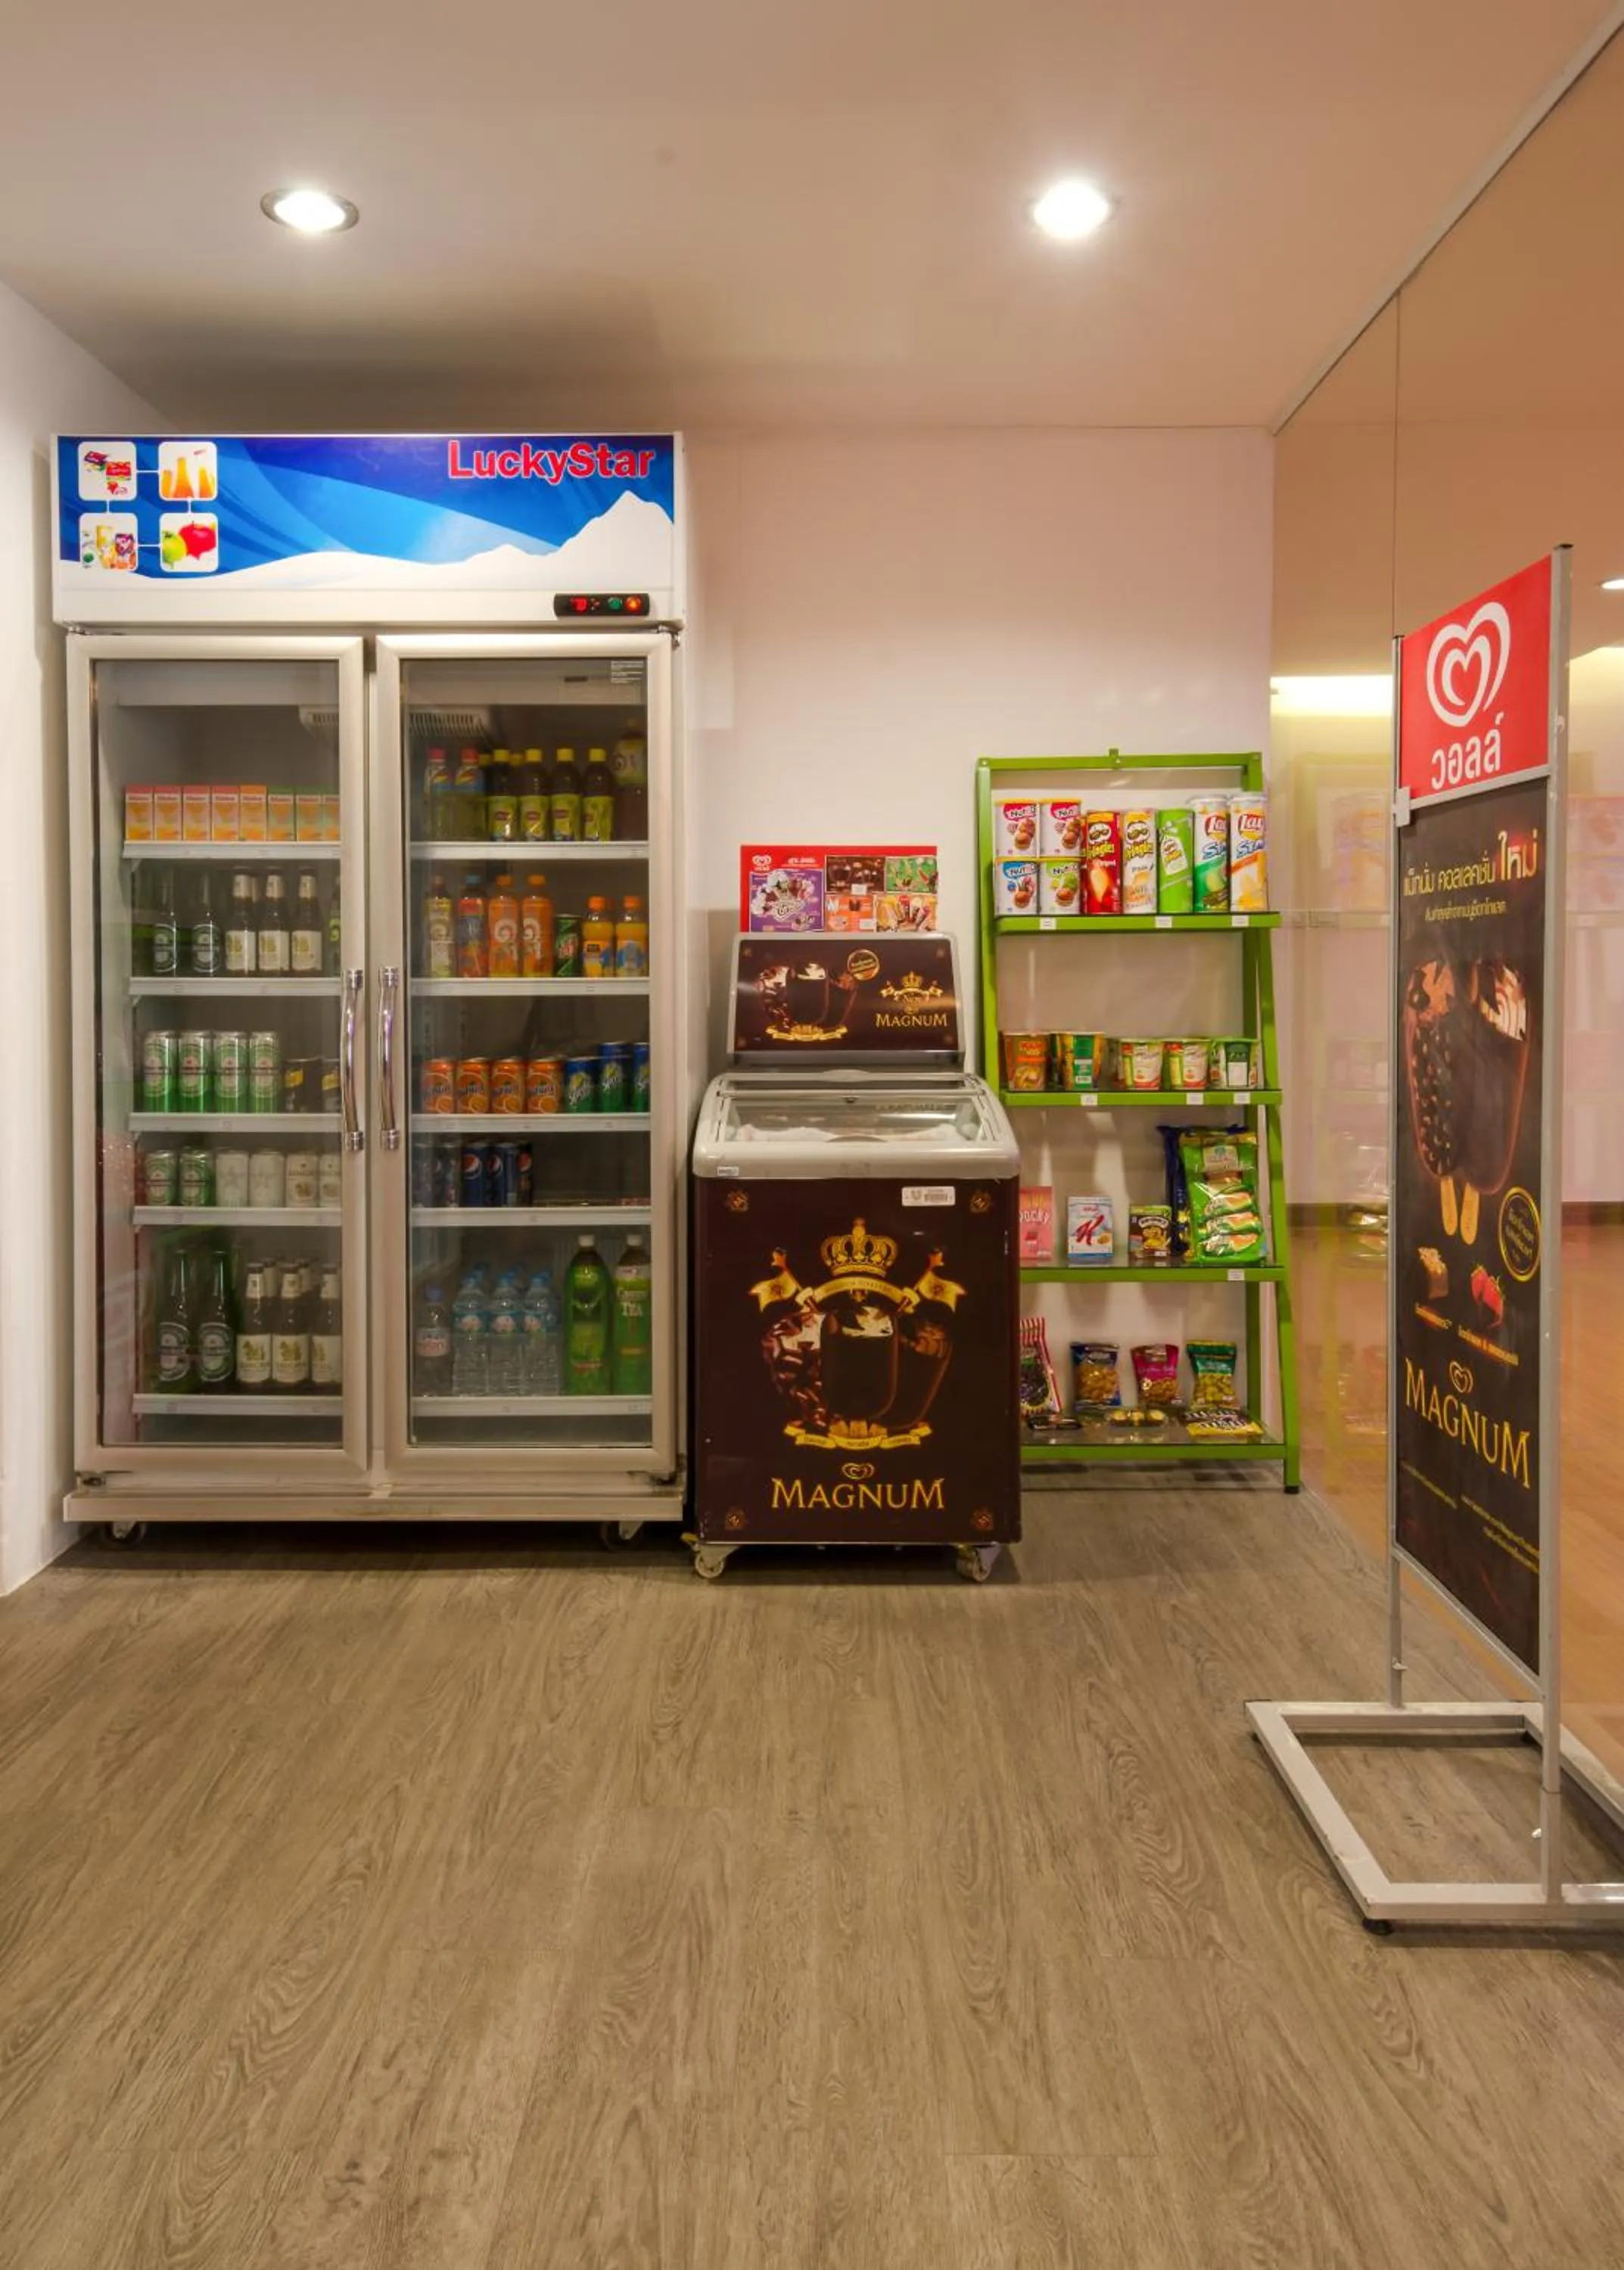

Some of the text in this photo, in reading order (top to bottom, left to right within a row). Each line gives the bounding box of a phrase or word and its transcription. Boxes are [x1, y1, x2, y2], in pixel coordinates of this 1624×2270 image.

[449, 440, 655, 485] LuckyStar
[1431, 712, 1504, 790] วอลล์
[1497, 828, 1538, 882] ใหม่
[875, 1012, 948, 1028] MAGNUM
[1405, 1357, 1531, 1490] MAGNUM
[771, 1478, 944, 1509] MAGNUM
